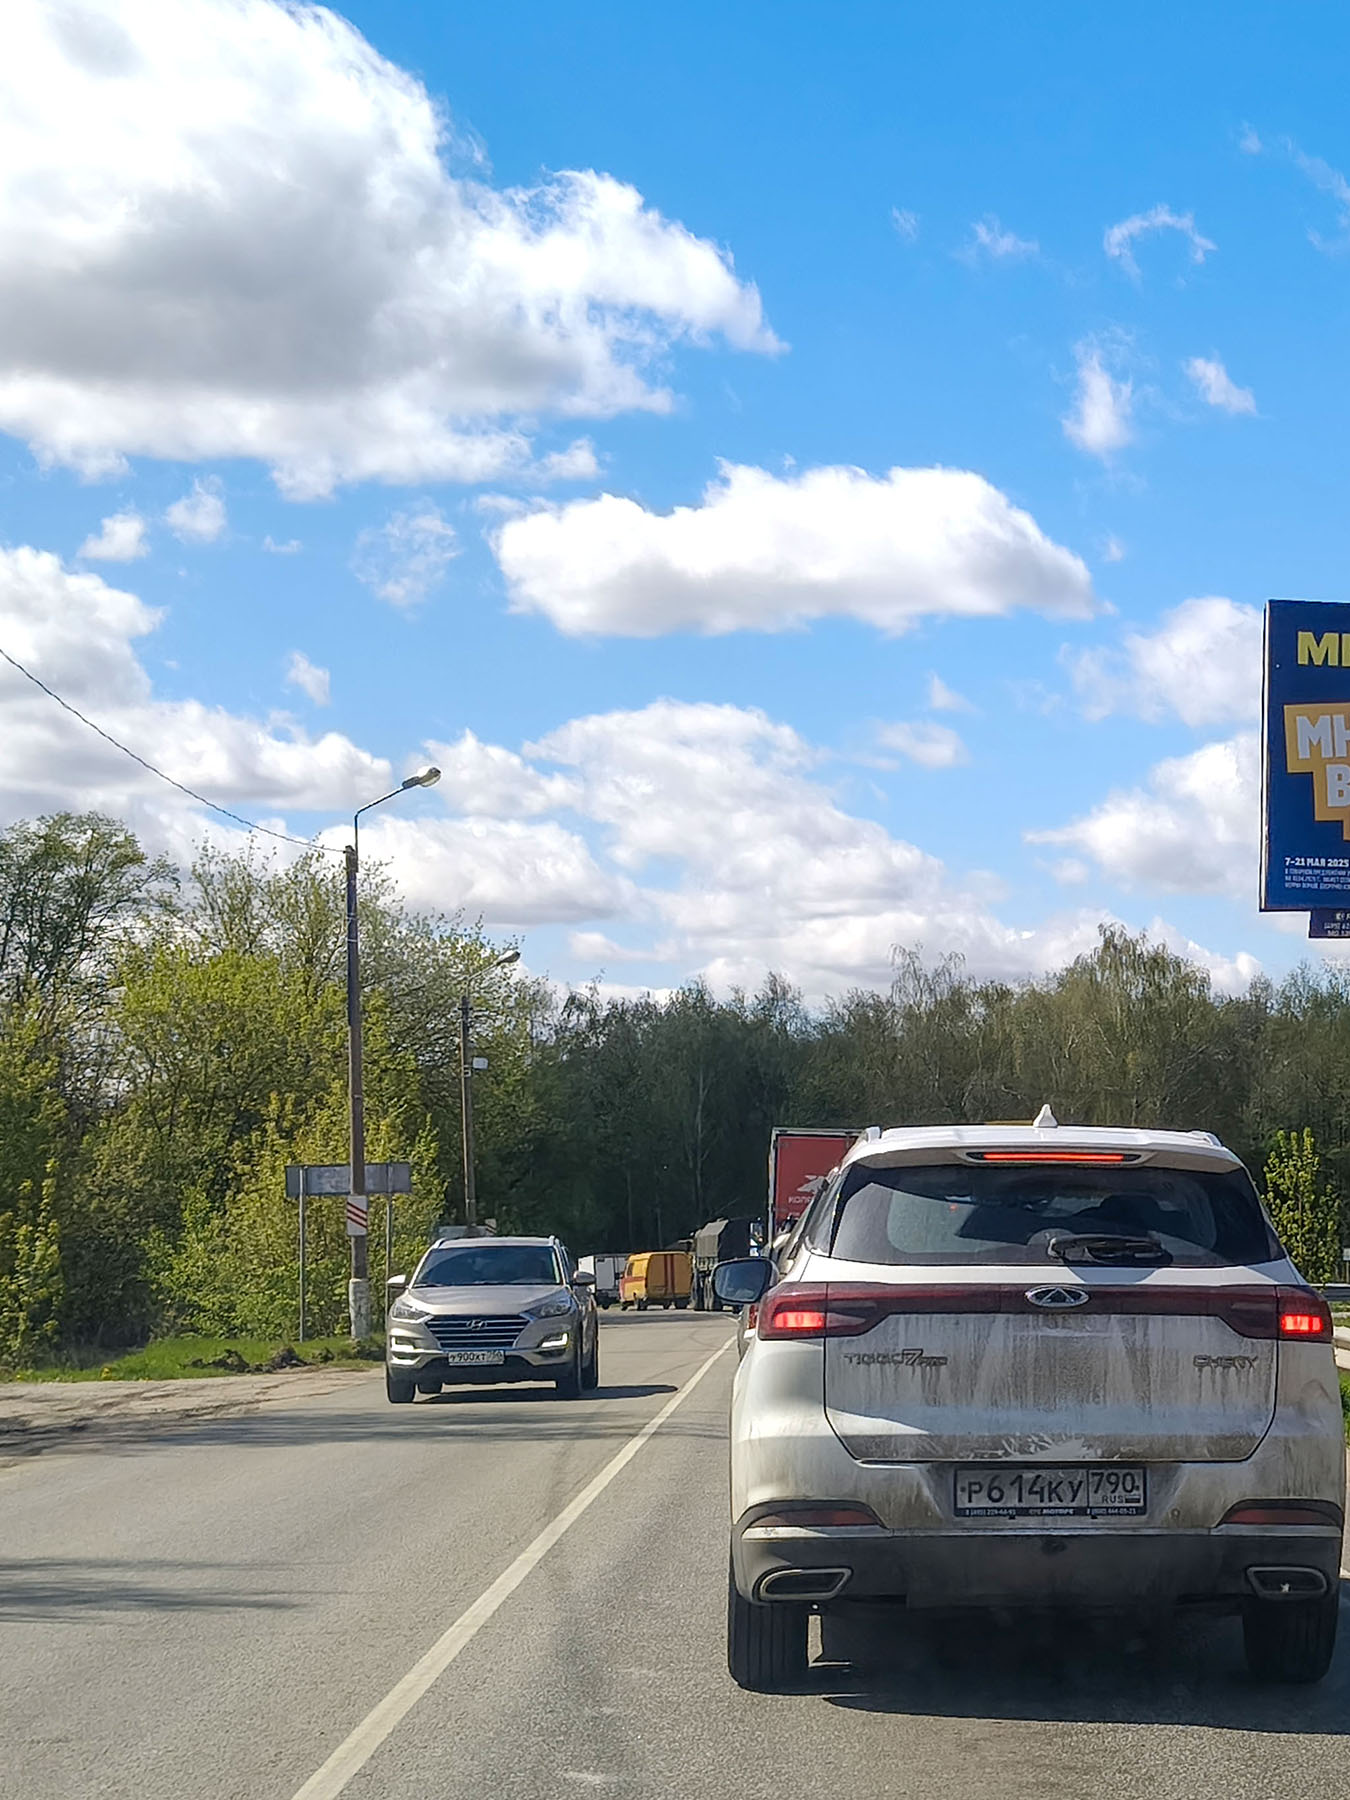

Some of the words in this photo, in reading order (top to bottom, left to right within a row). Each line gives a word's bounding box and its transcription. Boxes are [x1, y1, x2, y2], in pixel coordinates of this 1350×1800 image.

[1327, 858, 1350, 868] 2025
[1193, 1355, 1259, 1369] CHERY
[1090, 1472, 1137, 1494] 790
[1101, 1495, 1124, 1504] RUS
